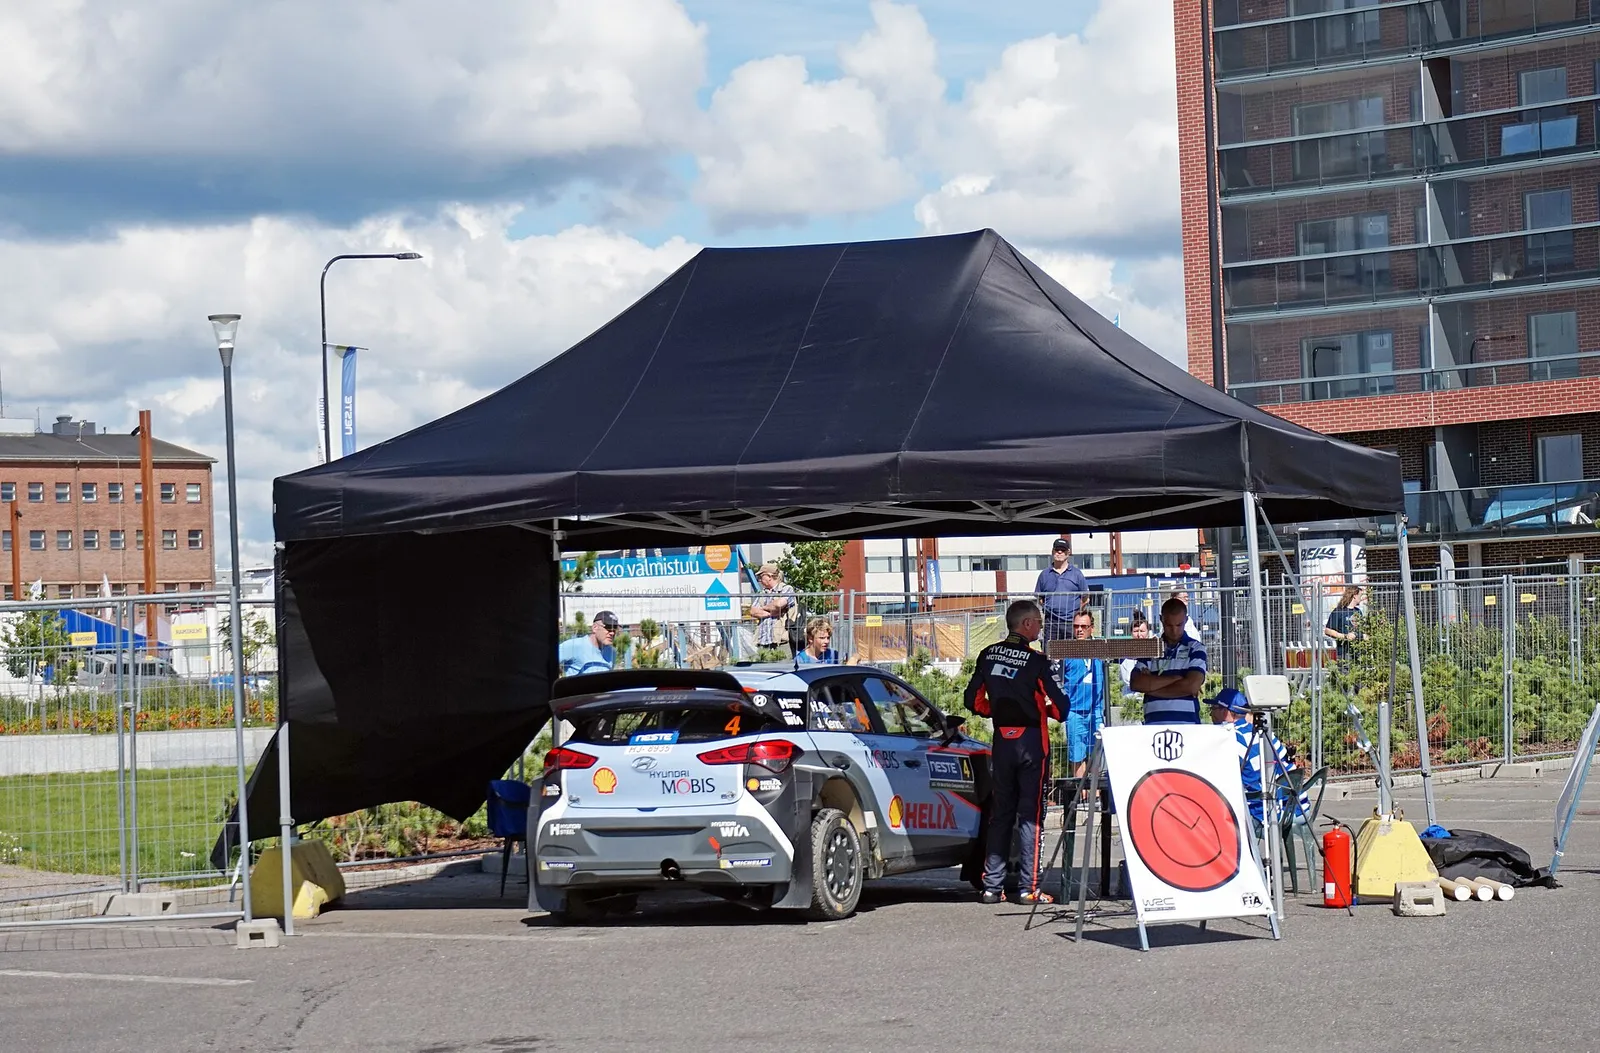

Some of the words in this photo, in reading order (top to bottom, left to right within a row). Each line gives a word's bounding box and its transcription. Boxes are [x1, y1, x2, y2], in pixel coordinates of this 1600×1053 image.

[626, 557, 700, 577] valmistuu
[654, 584, 697, 594] rakenteilla
[986, 654, 1028, 667] MOTORSPORT
[989, 645, 1031, 660] HYUNDAI
[724, 715, 741, 736] 4
[635, 733, 674, 742] NESTE
[864, 750, 900, 769] MOBIS
[649, 770, 690, 778] HYUNDAI
[930, 760, 958, 774] NESTE
[963, 759, 971, 778] 4
[661, 778, 716, 795] MOBIS
[905, 799, 958, 830] HELIX
[1142, 897, 1176, 907] WRC
